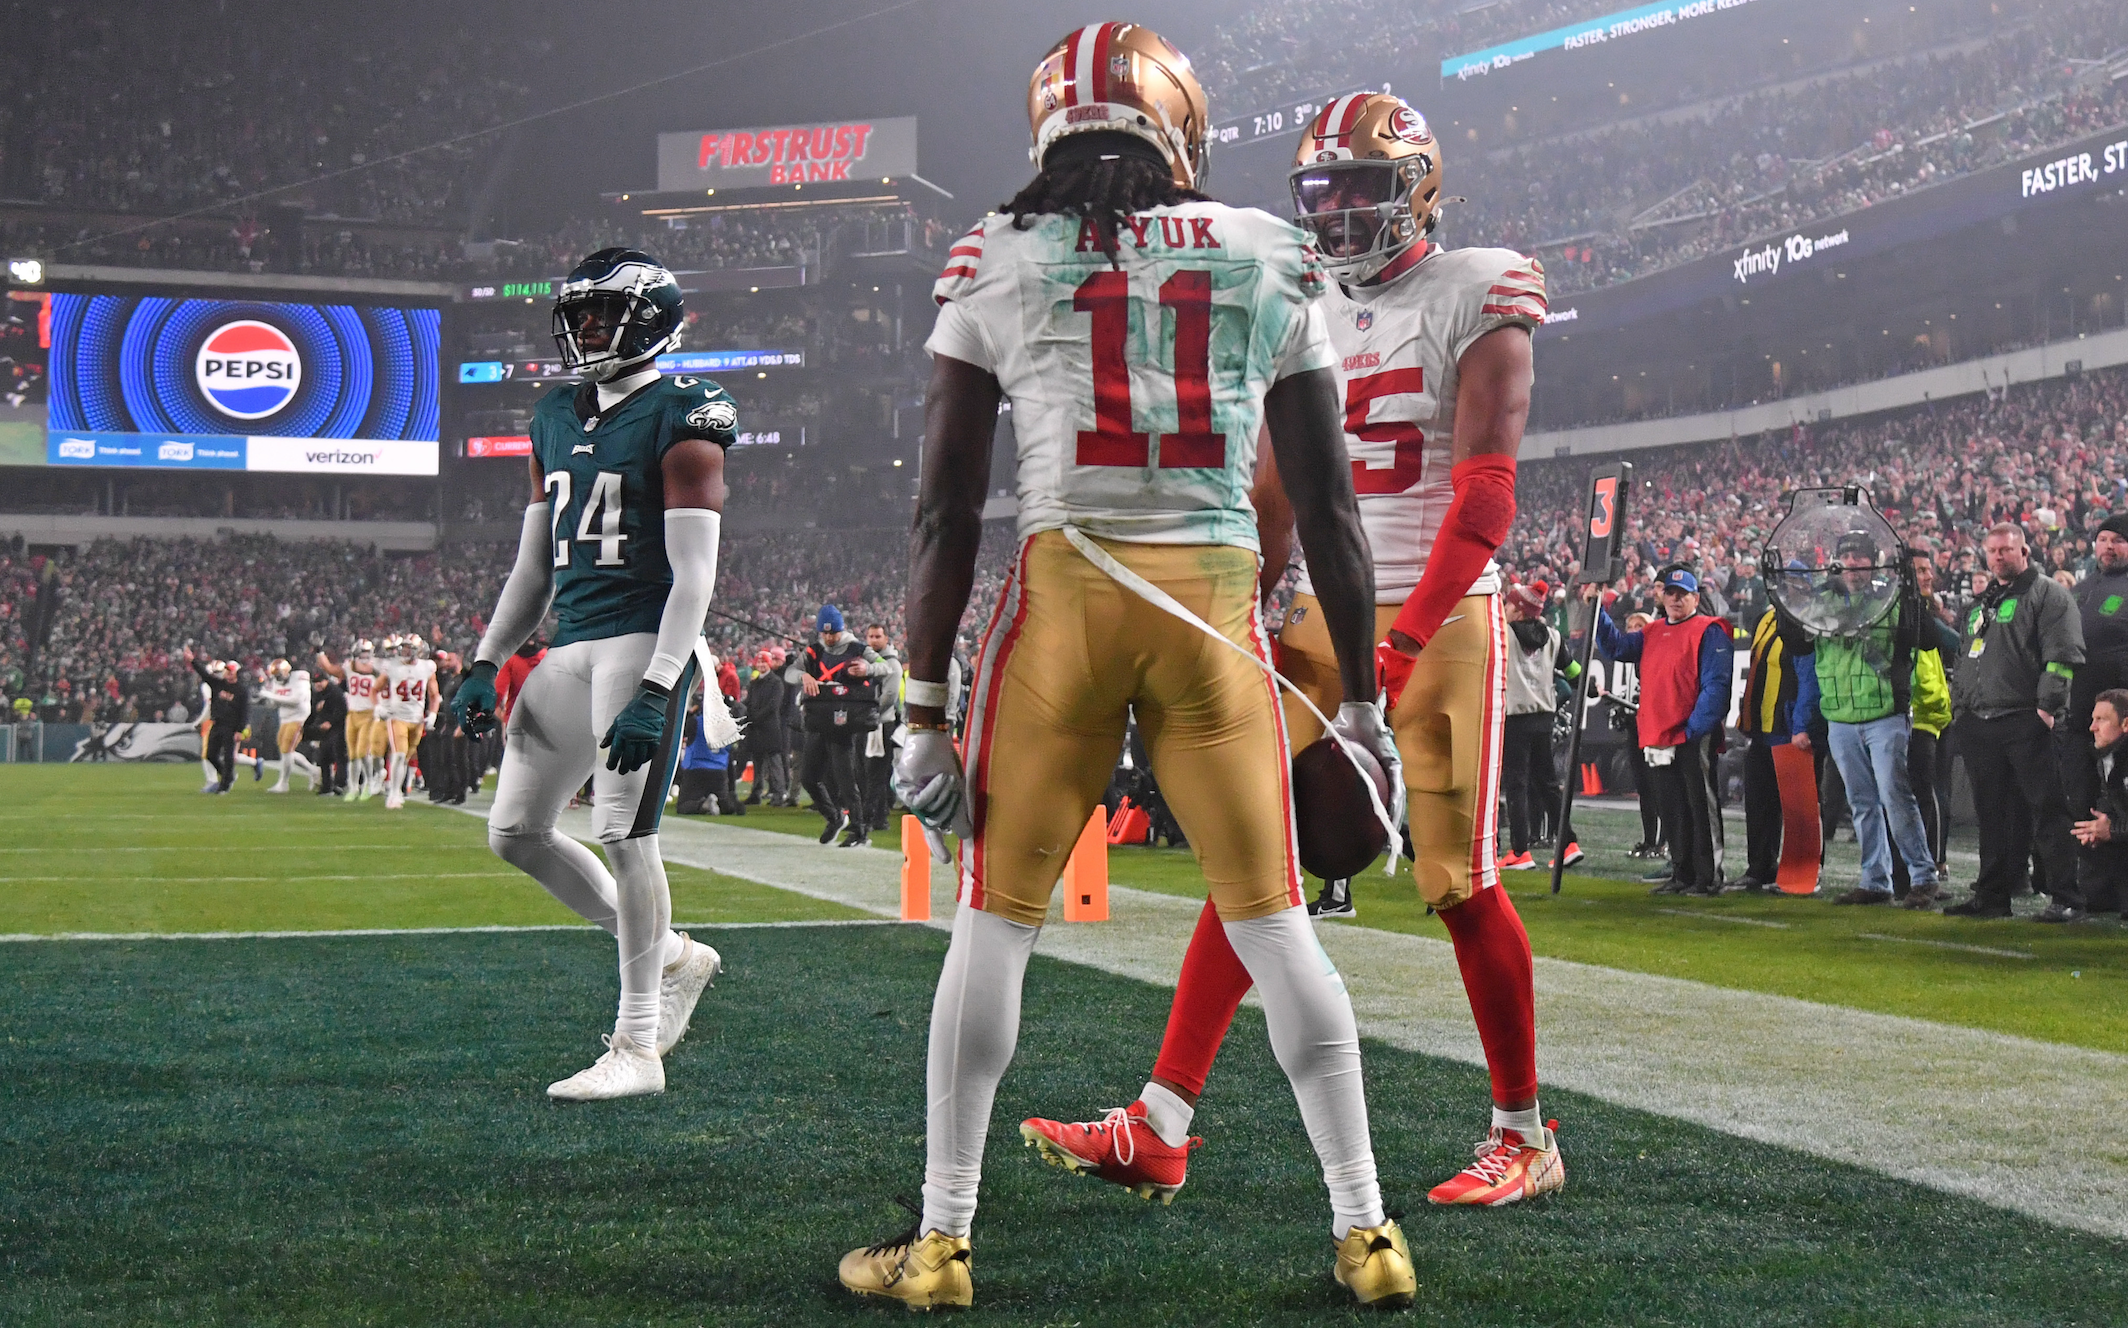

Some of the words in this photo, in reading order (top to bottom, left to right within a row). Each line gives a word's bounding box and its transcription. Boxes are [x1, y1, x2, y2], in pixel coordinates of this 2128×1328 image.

[1679, 0, 1715, 20] MORE
[1254, 112, 1283, 135] 7:10
[770, 160, 850, 185] BANK
[2022, 152, 2099, 198] FASTER,
[2104, 140, 2128, 173] ST
[1075, 217, 1221, 253] AYUK
[1733, 243, 1782, 283] xfinity
[1815, 229, 1849, 251] network
[503, 282, 551, 297] $114,115
[205, 358, 293, 380] PEPSI
[505, 364, 514, 379] 7
[1073, 270, 1226, 468] 11
[756, 431, 780, 444] 6:48
[306, 448, 374, 465] verizon
[545, 470, 628, 566] 24
[1590, 477, 1617, 538] 3
[350, 676, 372, 697] 89
[396, 679, 424, 702] 44
